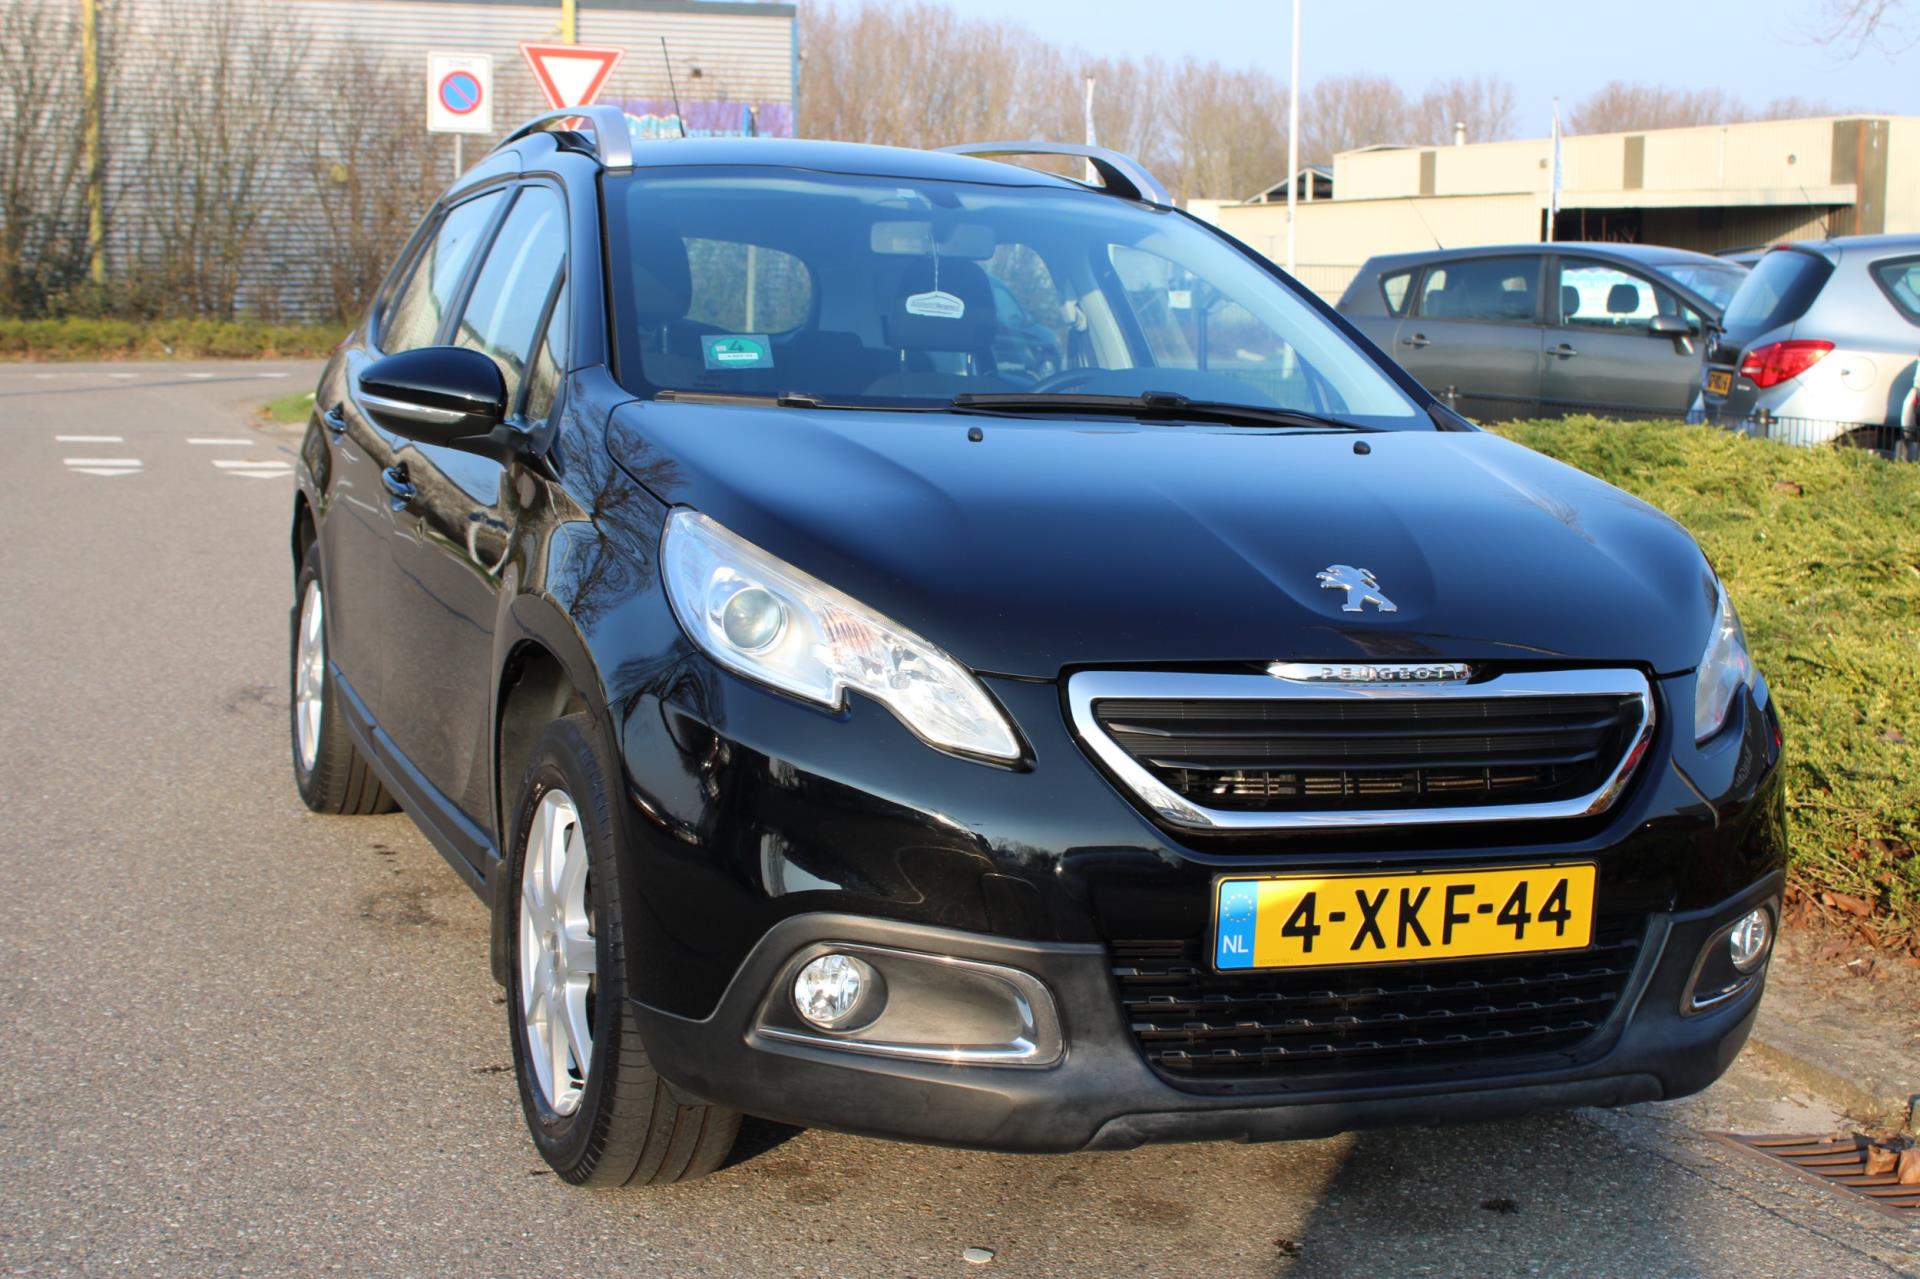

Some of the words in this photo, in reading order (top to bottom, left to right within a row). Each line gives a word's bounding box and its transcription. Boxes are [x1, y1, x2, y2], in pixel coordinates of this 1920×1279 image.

[1321, 666, 1446, 681] PEUGEOT
[1281, 878, 1572, 953] 4-XKF-44
[1222, 934, 1249, 954] NL
